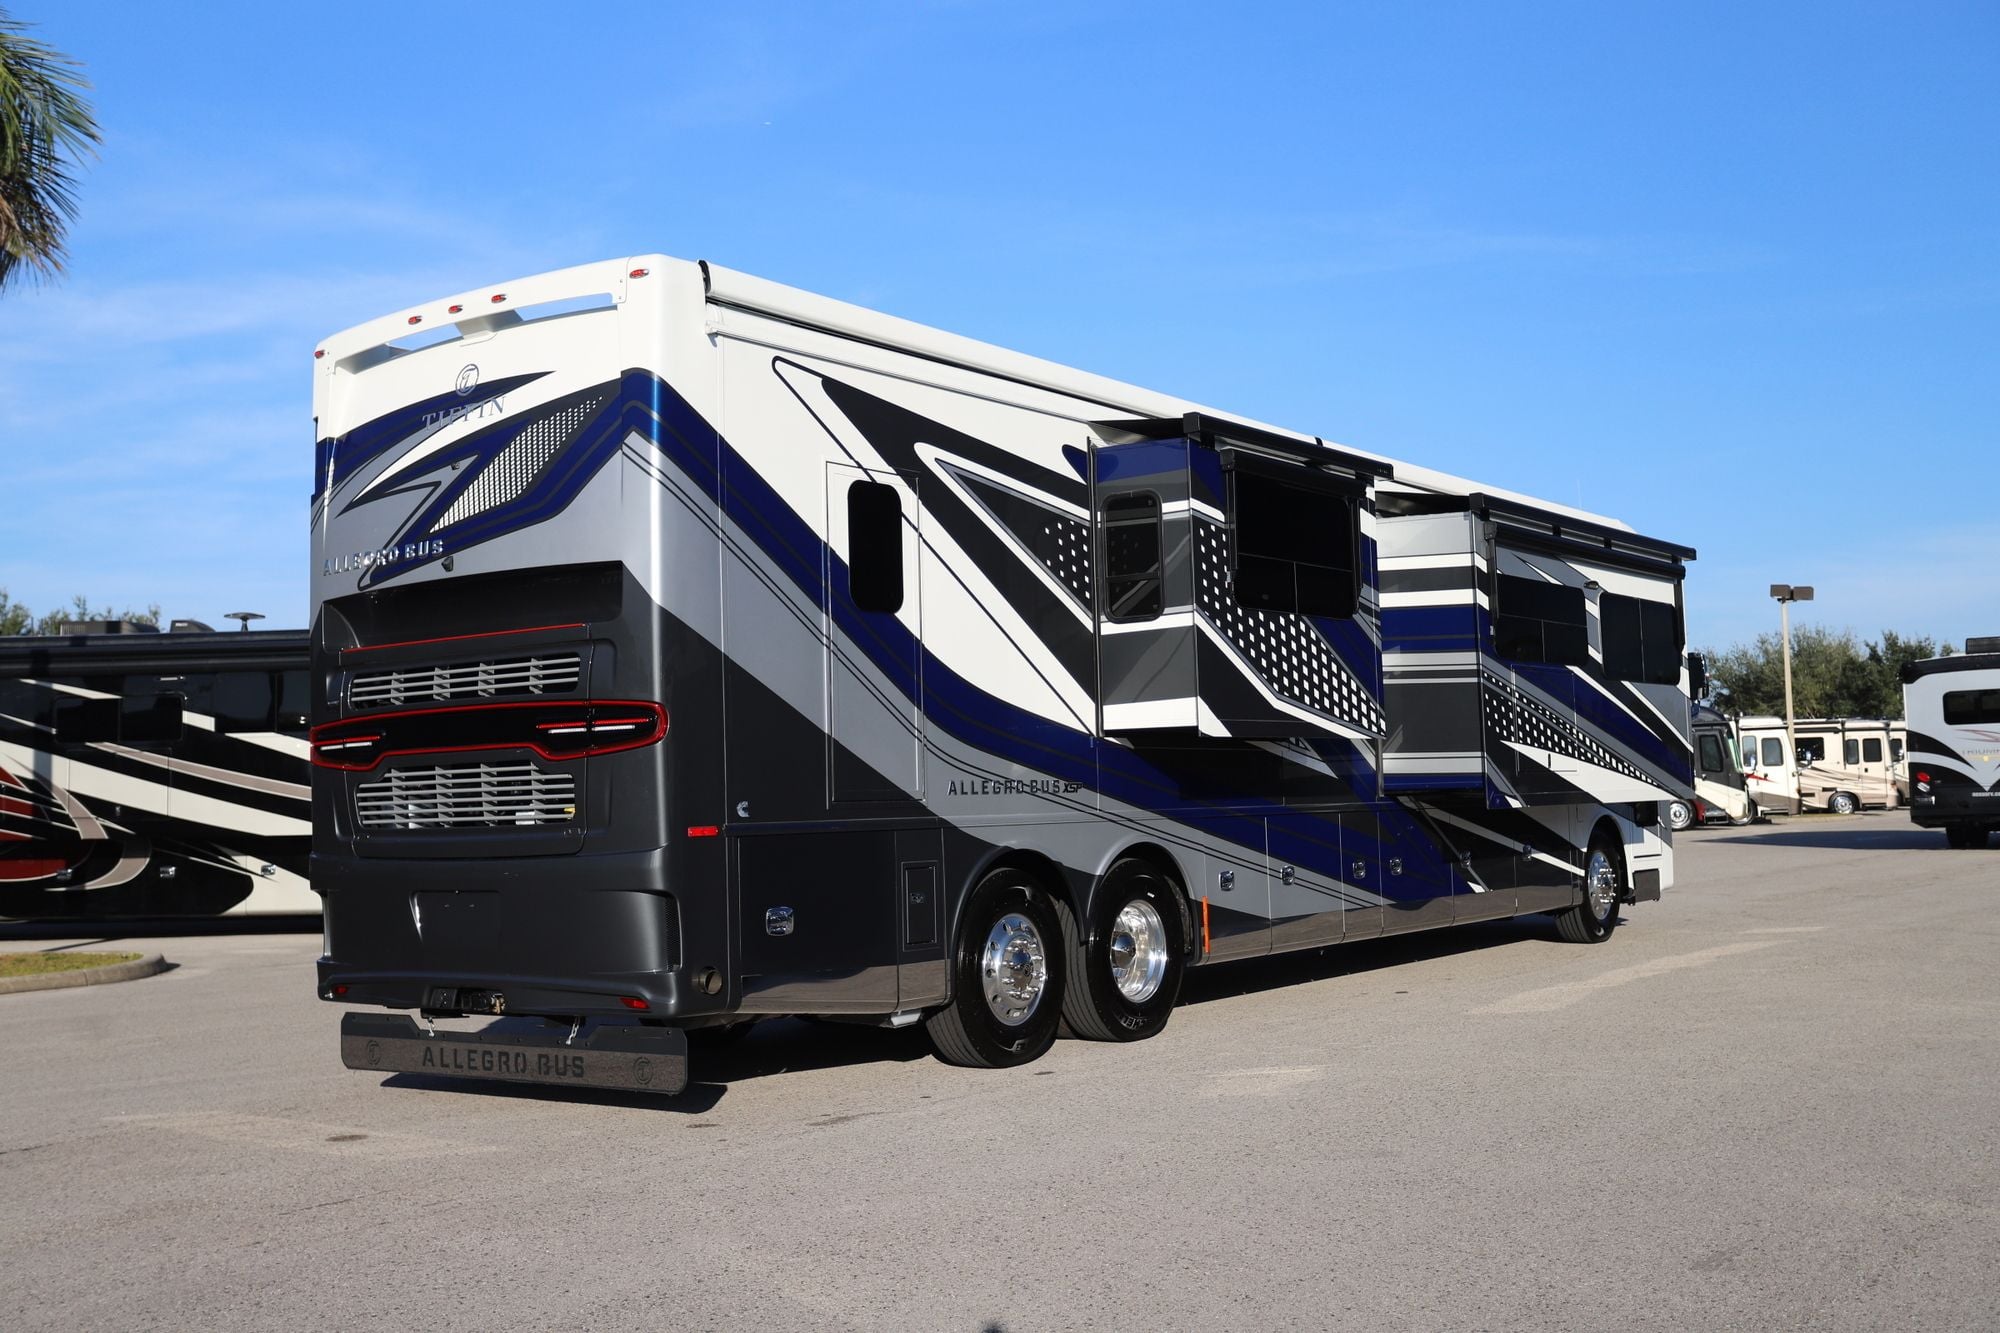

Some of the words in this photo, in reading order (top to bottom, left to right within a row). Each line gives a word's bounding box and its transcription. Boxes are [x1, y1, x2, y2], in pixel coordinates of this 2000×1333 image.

[422, 396, 506, 431] TIFFIN
[323, 546, 400, 576] ALLEGRO
[405, 539, 444, 559] BUS
[947, 779, 1024, 796] ALLEGRO
[1030, 779, 1060, 794] BUS
[422, 1046, 527, 1074] ALLEGRO
[537, 1053, 585, 1078] BUS
